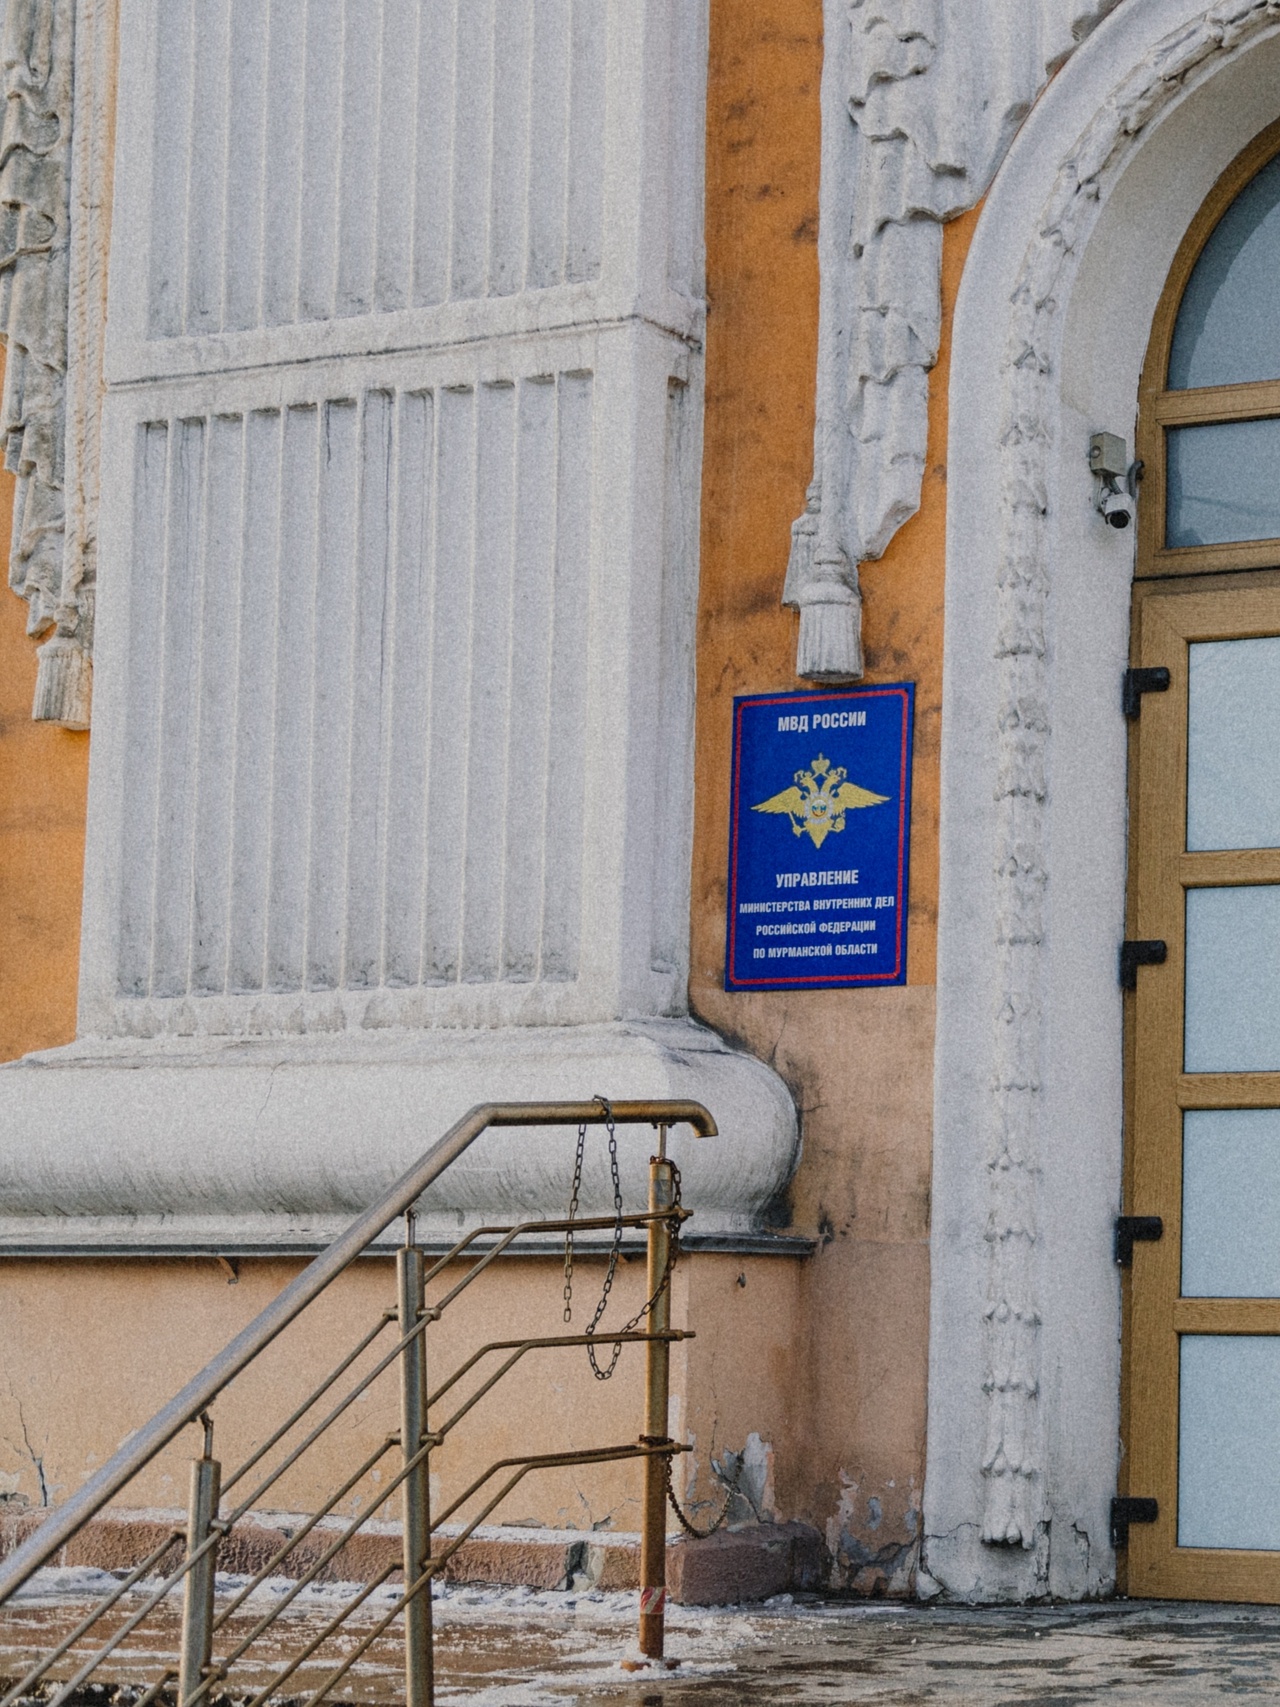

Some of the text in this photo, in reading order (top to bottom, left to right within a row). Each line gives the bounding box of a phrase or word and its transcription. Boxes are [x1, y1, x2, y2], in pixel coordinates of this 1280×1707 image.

[777, 710, 867, 733] МВД РОССИИ
[776, 869, 859, 888] УПРАВЛЕНИЕ
[739, 895, 895, 914] МИНИСТЕРСТВА ВНУТРЕННИХ ДЕЛ
[756, 920, 876, 936] РОССИЙСКОЙ ФЕДЕРАЦИИ
[753, 943, 878, 959] ПО МУРМАНСКОЙ ОБЛАСТИ
